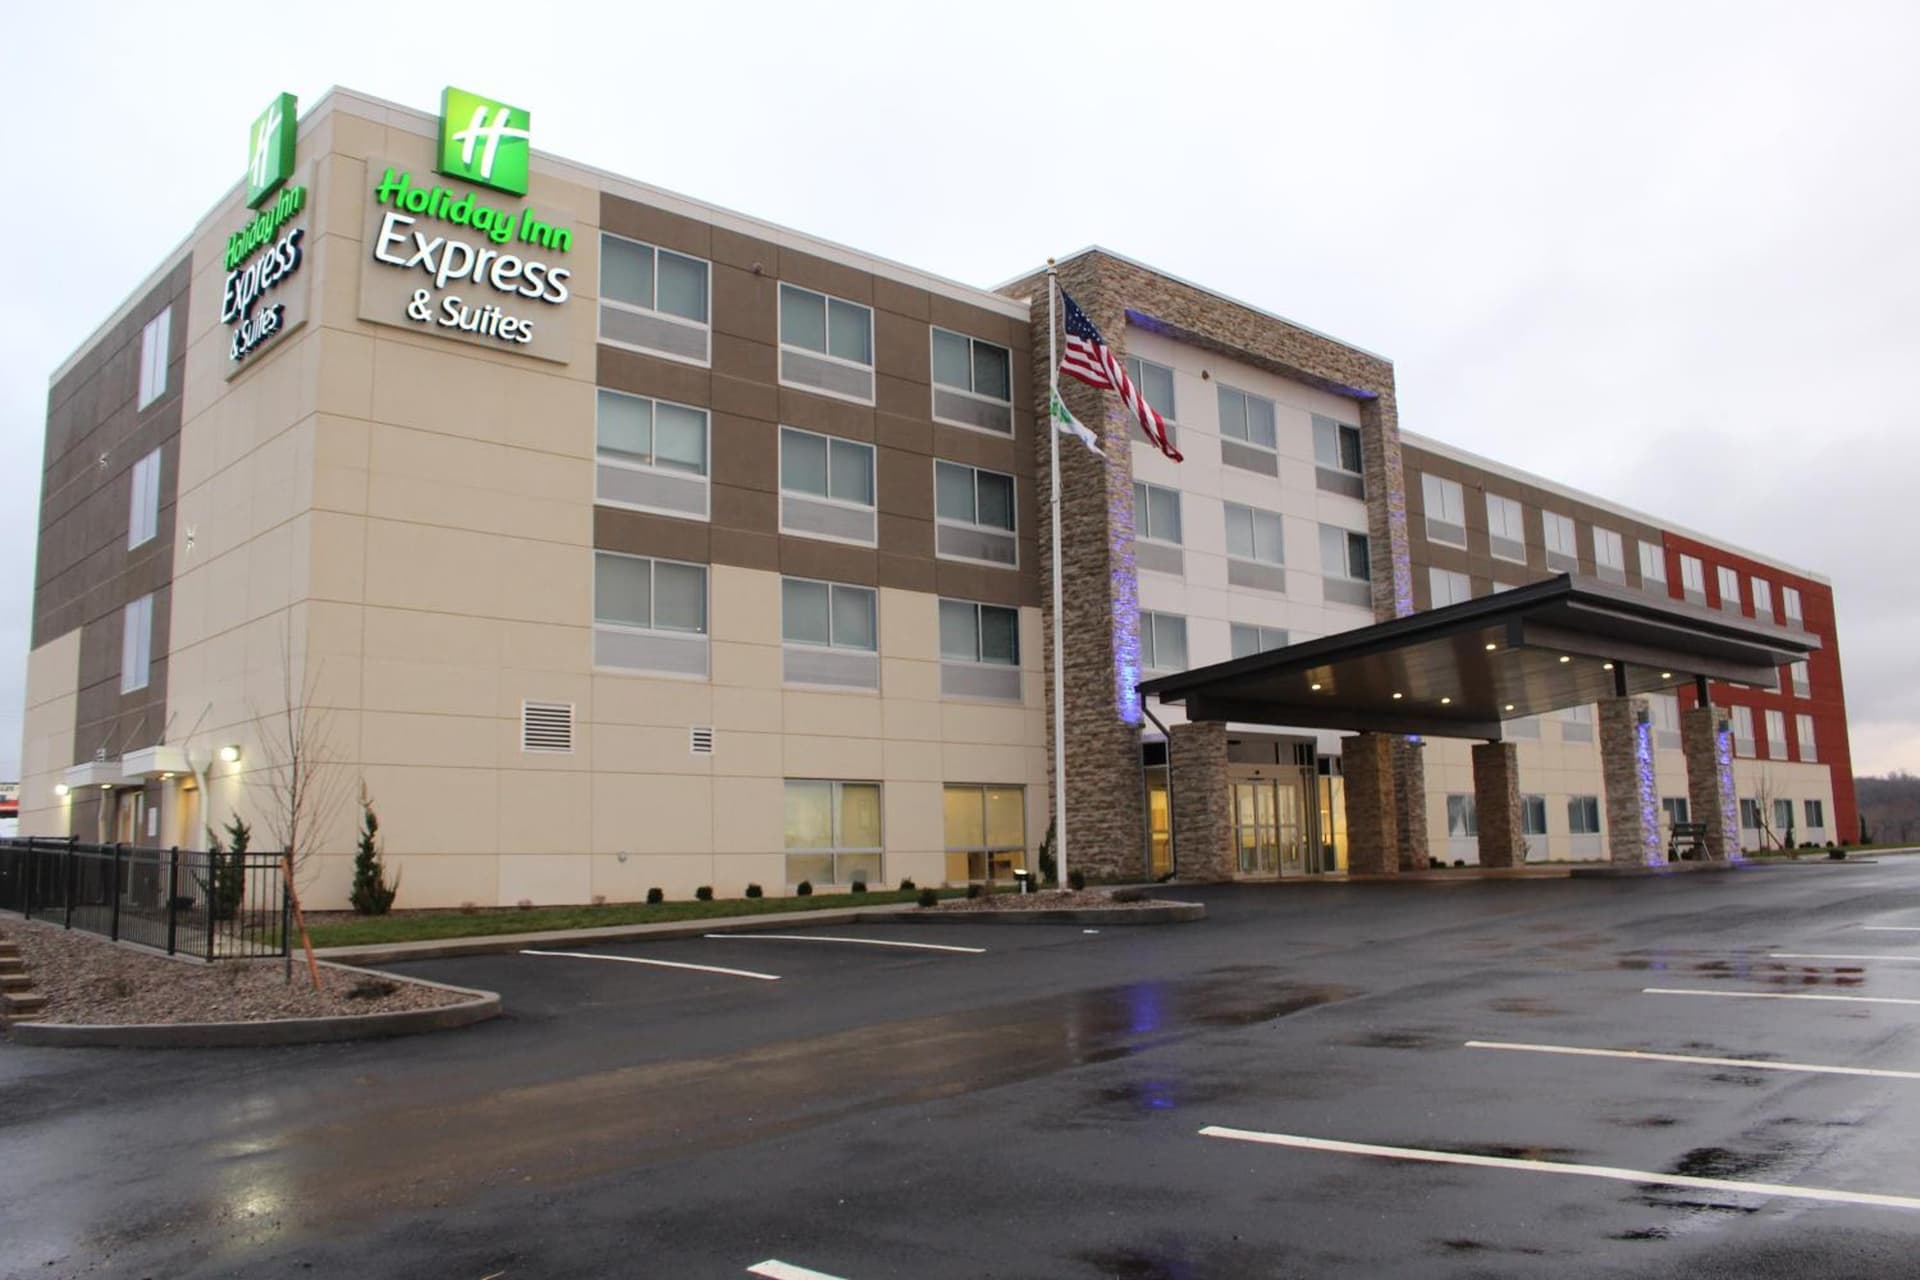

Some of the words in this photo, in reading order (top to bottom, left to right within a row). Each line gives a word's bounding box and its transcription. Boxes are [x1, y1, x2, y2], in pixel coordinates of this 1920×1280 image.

[224, 207, 277, 272] Holiday
[275, 185, 306, 226] Inn
[374, 168, 516, 243] Holiday
[518, 208, 573, 252] Inn
[221, 228, 304, 325] Express
[374, 211, 571, 304] Express
[229, 329, 242, 361] &
[239, 303, 286, 354] Suites
[407, 288, 432, 322] &
[438, 295, 534, 344] Suites
